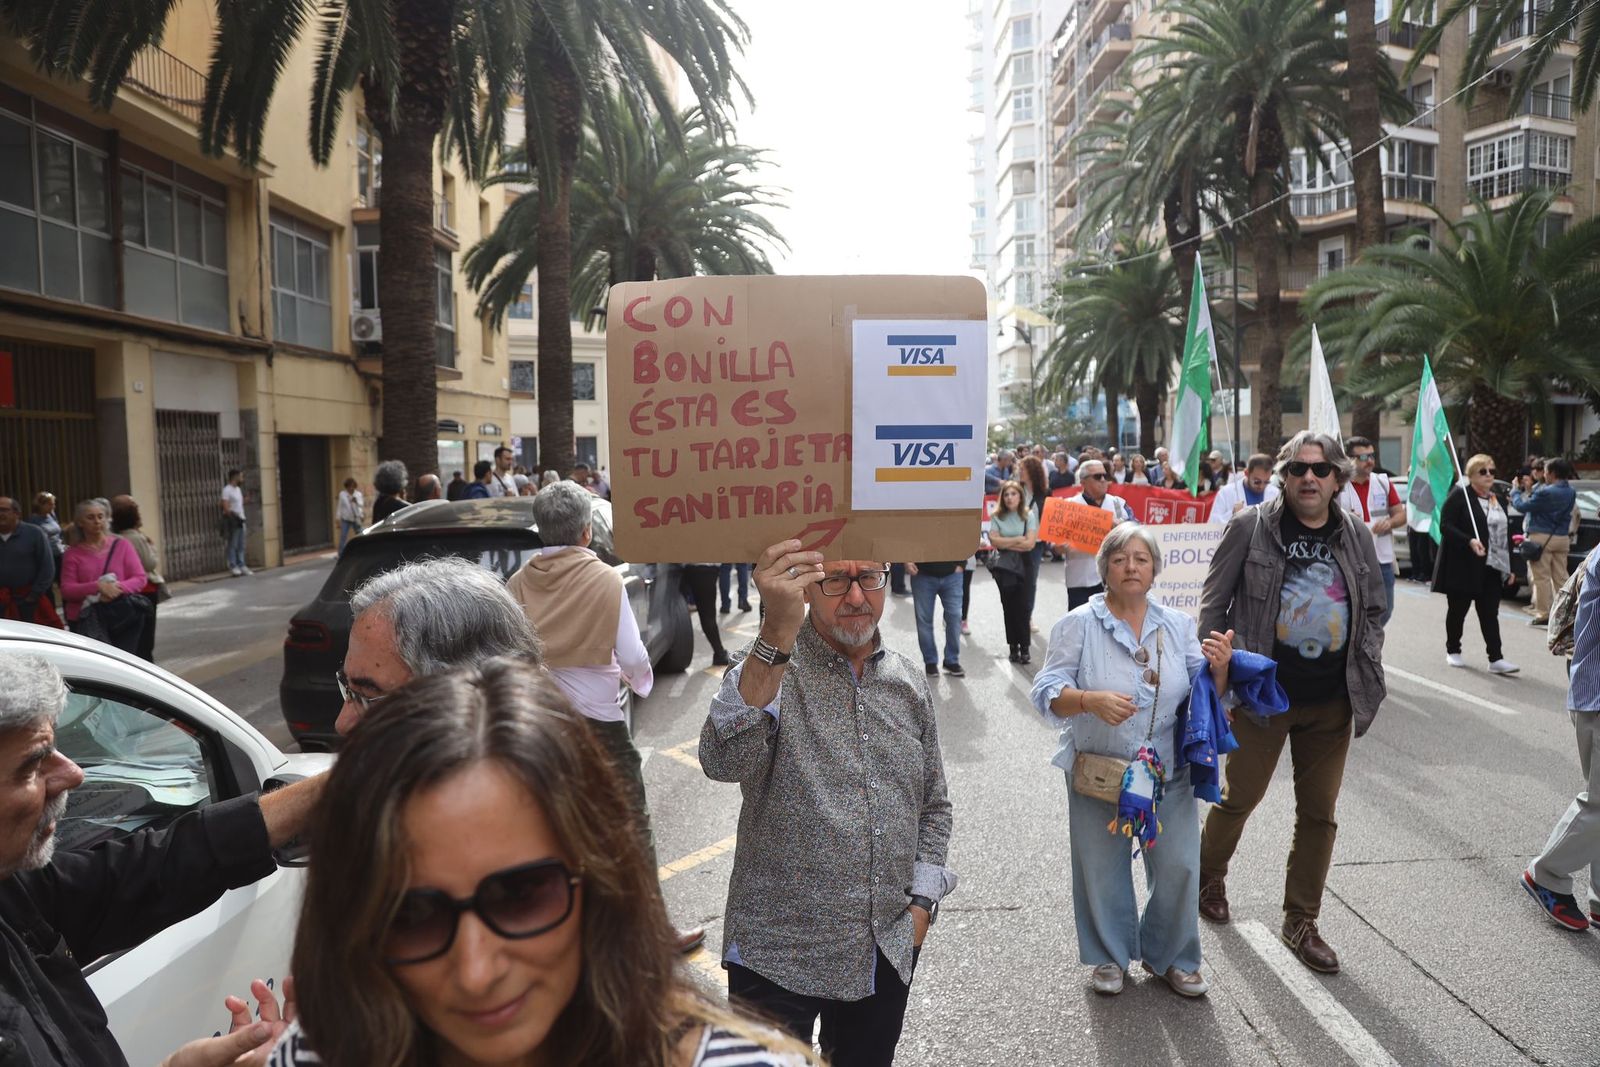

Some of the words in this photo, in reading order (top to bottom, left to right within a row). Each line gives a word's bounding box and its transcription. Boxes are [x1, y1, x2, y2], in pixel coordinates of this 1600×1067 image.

[623, 295, 733, 332] CON
[899, 347, 945, 365] VISA
[628, 388, 718, 436] ÉSTA
[731, 388, 797, 427] ES
[623, 447, 678, 478] TU
[891, 442, 955, 466] VISA
[1162, 592, 1201, 607] MÉRI
